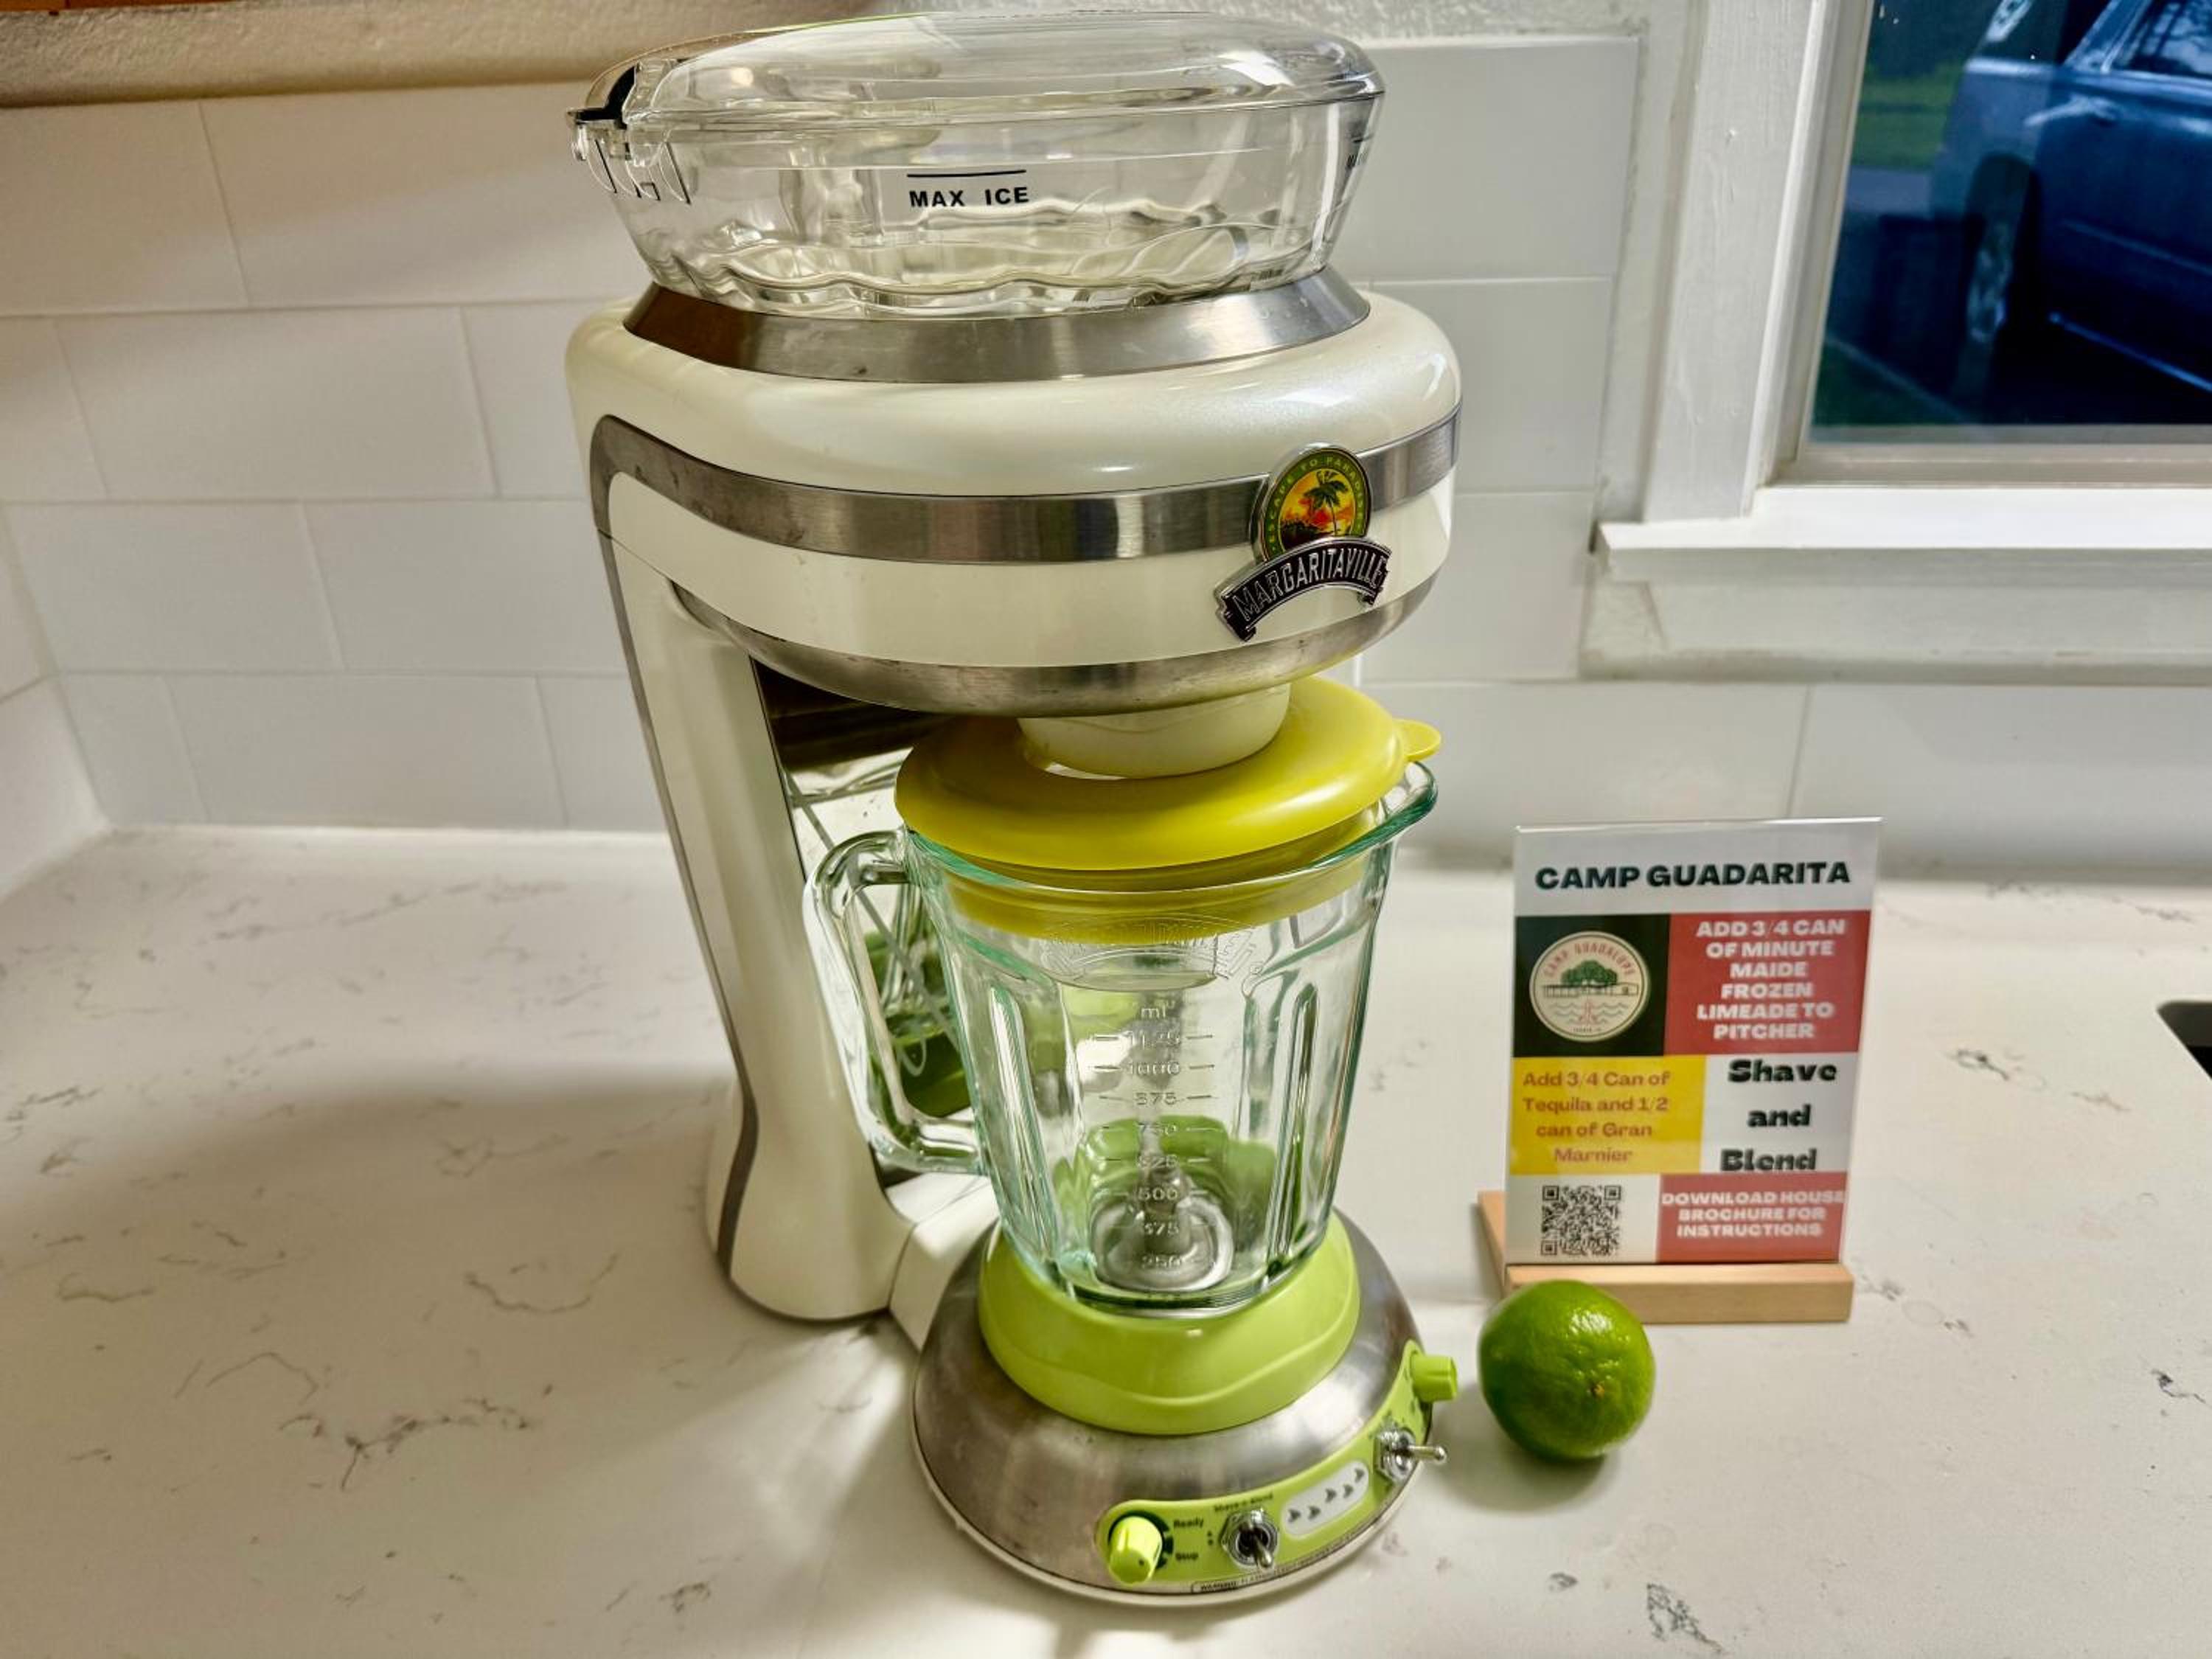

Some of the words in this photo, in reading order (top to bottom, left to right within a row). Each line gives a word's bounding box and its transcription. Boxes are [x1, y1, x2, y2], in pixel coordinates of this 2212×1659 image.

[909, 189, 965, 207] MAX
[984, 187, 1029, 206] ICE
[1232, 548, 1388, 622] MARGARITAVILLE
[1535, 866, 1640, 891] CAMP
[1646, 861, 1851, 887] GUADARITA
[1697, 922, 1747, 937] ADD
[1792, 919, 1846, 936] CAN
[1706, 942, 1737, 958] OF
[1742, 940, 1834, 957] MINUTE
[1730, 961, 1808, 978] MAIDE
[1721, 982, 1814, 999] FROZEN
[1697, 1003, 1798, 1020] LIMEADE
[1802, 1001, 1835, 1018] TO
[1714, 1023, 1815, 1039] PITCHER
[1523, 1071, 1562, 1086] Add
[1604, 1071, 1643, 1086] Can
[1648, 1071, 1670, 1085] of
[1728, 1060, 1837, 1082] Shave
[1523, 1097, 1592, 1114] Tequila
[1596, 1097, 1633, 1111] and
[1747, 1105, 1811, 1127] and
[1536, 1124, 1571, 1138] can
[1576, 1121, 1598, 1138] of
[1602, 1122, 1652, 1138] Gran
[1555, 1147, 1632, 1163] Marnier
[1720, 1149, 1817, 1172] Blend
[1661, 1192, 1777, 1204] DOWNLOAD
[1780, 1190, 1846, 1203] HOUSE
[1679, 1207, 1784, 1221] BROCHURE
[1788, 1207, 1826, 1220] FOR
[1677, 1222, 1823, 1237] INSTRUCTIONS
